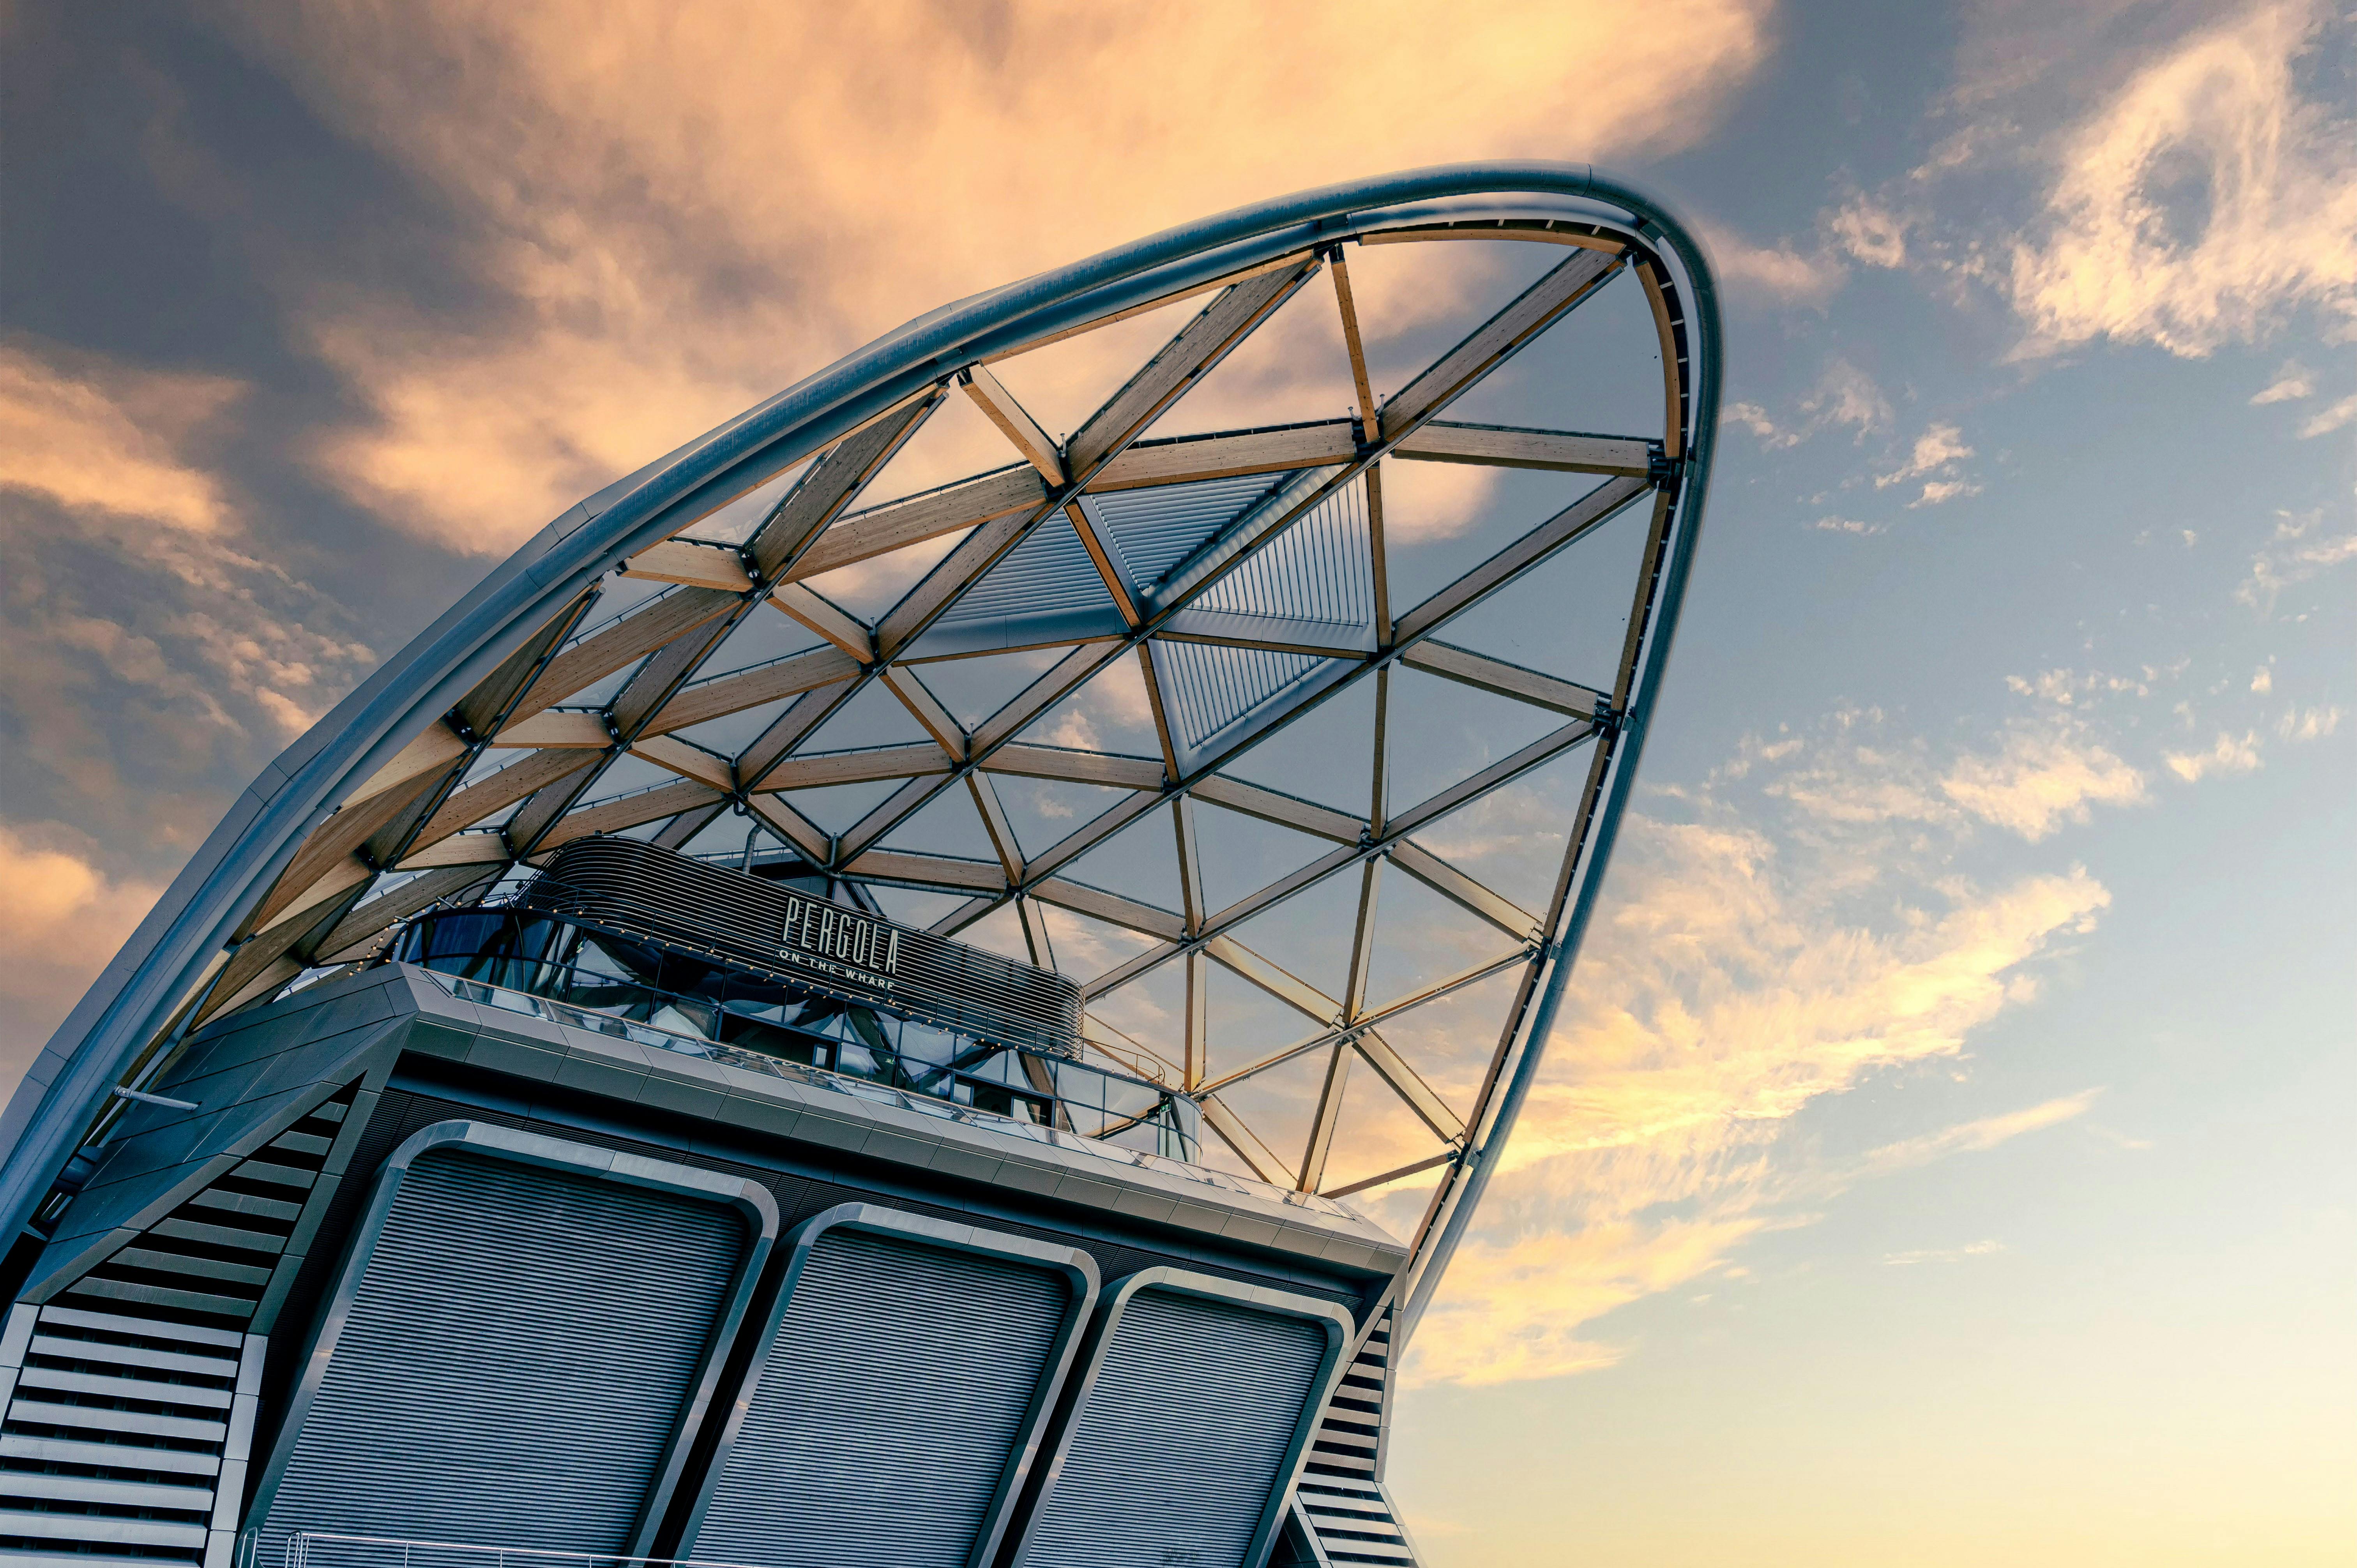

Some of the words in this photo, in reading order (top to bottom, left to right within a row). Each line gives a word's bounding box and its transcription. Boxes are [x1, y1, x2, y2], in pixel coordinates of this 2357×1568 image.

[783, 897, 898, 974] PERGOLA
[779, 950, 800, 964] ON
[809, 958, 836, 974] THE
[846, 969, 895, 990] WHARF
